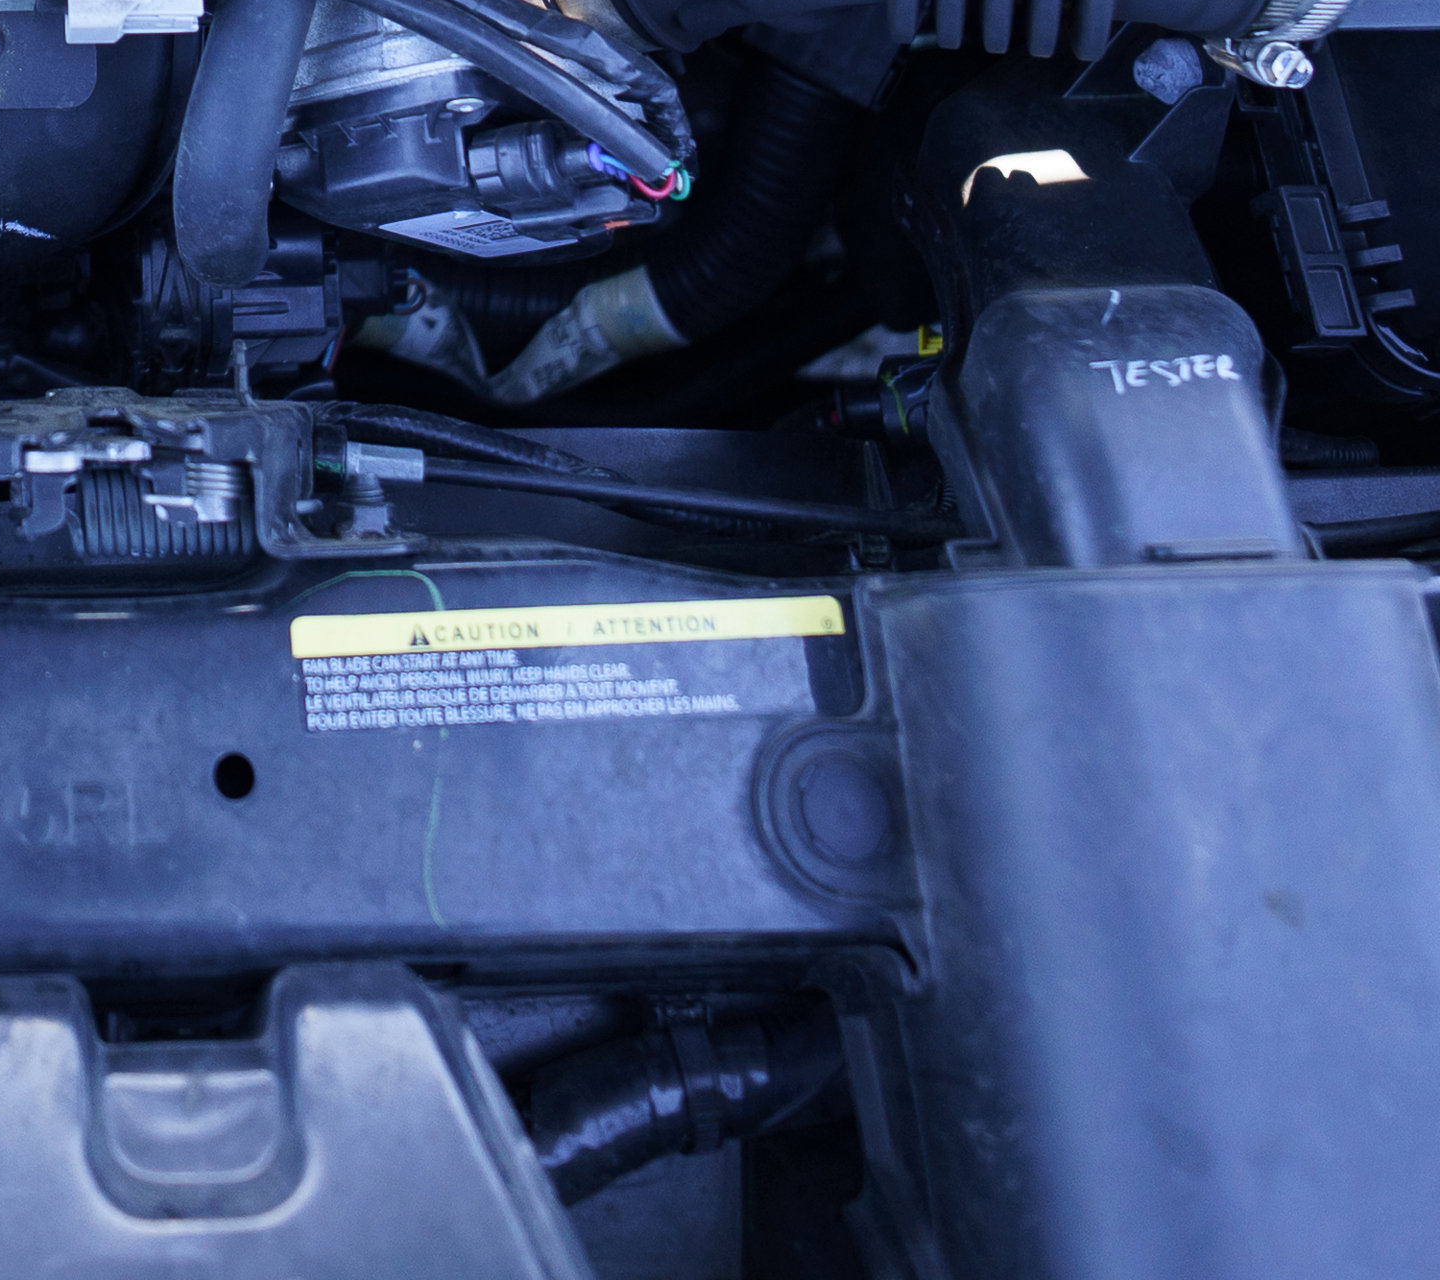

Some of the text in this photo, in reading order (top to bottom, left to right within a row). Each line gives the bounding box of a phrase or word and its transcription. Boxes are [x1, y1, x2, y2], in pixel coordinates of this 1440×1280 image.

[1088, 353, 1242, 395] TESTER
[434, 622, 540, 643] CAUTION
[592, 615, 717, 637] ATTENTION
[302, 658, 329, 676] FAN
[329, 656, 371, 675] BLADE
[371, 655, 401, 673] CAN
[401, 653, 440, 672] START
[441, 652, 459, 669] AT
[459, 650, 486, 669] ANY
[305, 676, 324, 694] TO
[325, 674, 358, 693] HELP
[359, 673, 399, 691] AVOID
[400, 670, 466, 689] PERSONAL
[513, 666, 542, 685] KEEP
[543, 664, 588, 683] HANDS
[305, 694, 323, 712] LE
[323, 691, 416, 711] VENTILATEUR
[417, 688, 468, 708] RISQUE
[469, 687, 488, 705] DE
[578, 681, 615, 699] TOUT
[306, 712, 348, 732] POUR
[397, 707, 444, 727] TOUTE
[516, 702, 537, 721] NE
[537, 701, 563, 720] PAS
[564, 700, 585, 719] EN
[586, 696, 665, 717] APPROCHER
[667, 695, 692, 715] LES
